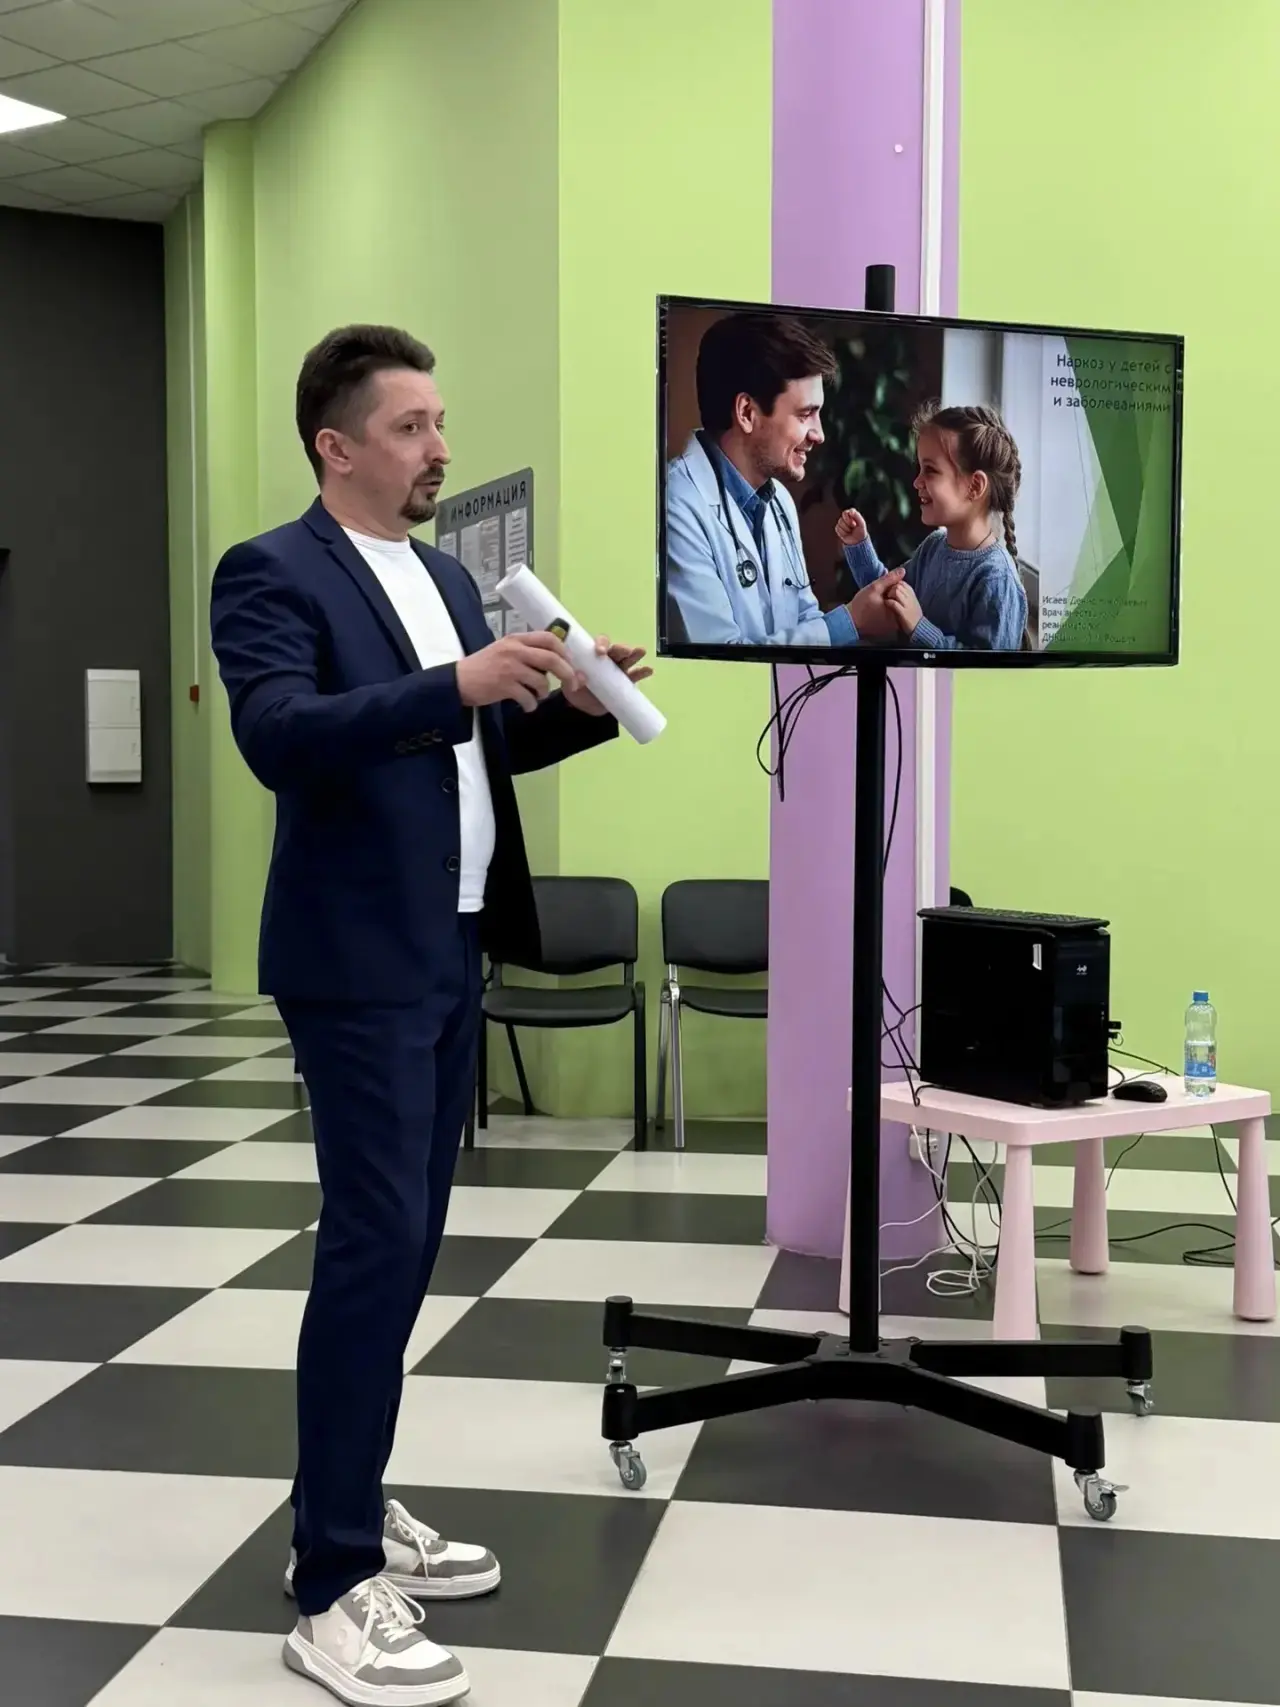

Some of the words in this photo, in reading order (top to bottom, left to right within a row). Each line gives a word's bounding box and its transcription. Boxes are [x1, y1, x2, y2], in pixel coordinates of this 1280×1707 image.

[1057, 353, 1104, 370] Наркоз
[1109, 361, 1116, 373] у
[1120, 360, 1160, 372] детей
[1164, 364, 1173, 374] с
[1050, 376, 1171, 393] неврологическим
[1053, 396, 1062, 407] и
[1066, 395, 1171, 412] заболеваниями
[451, 481, 527, 523] ИНФОРМАЦИЯ
[1042, 595, 1068, 605] Исаев
[1042, 607, 1063, 617] Врач
